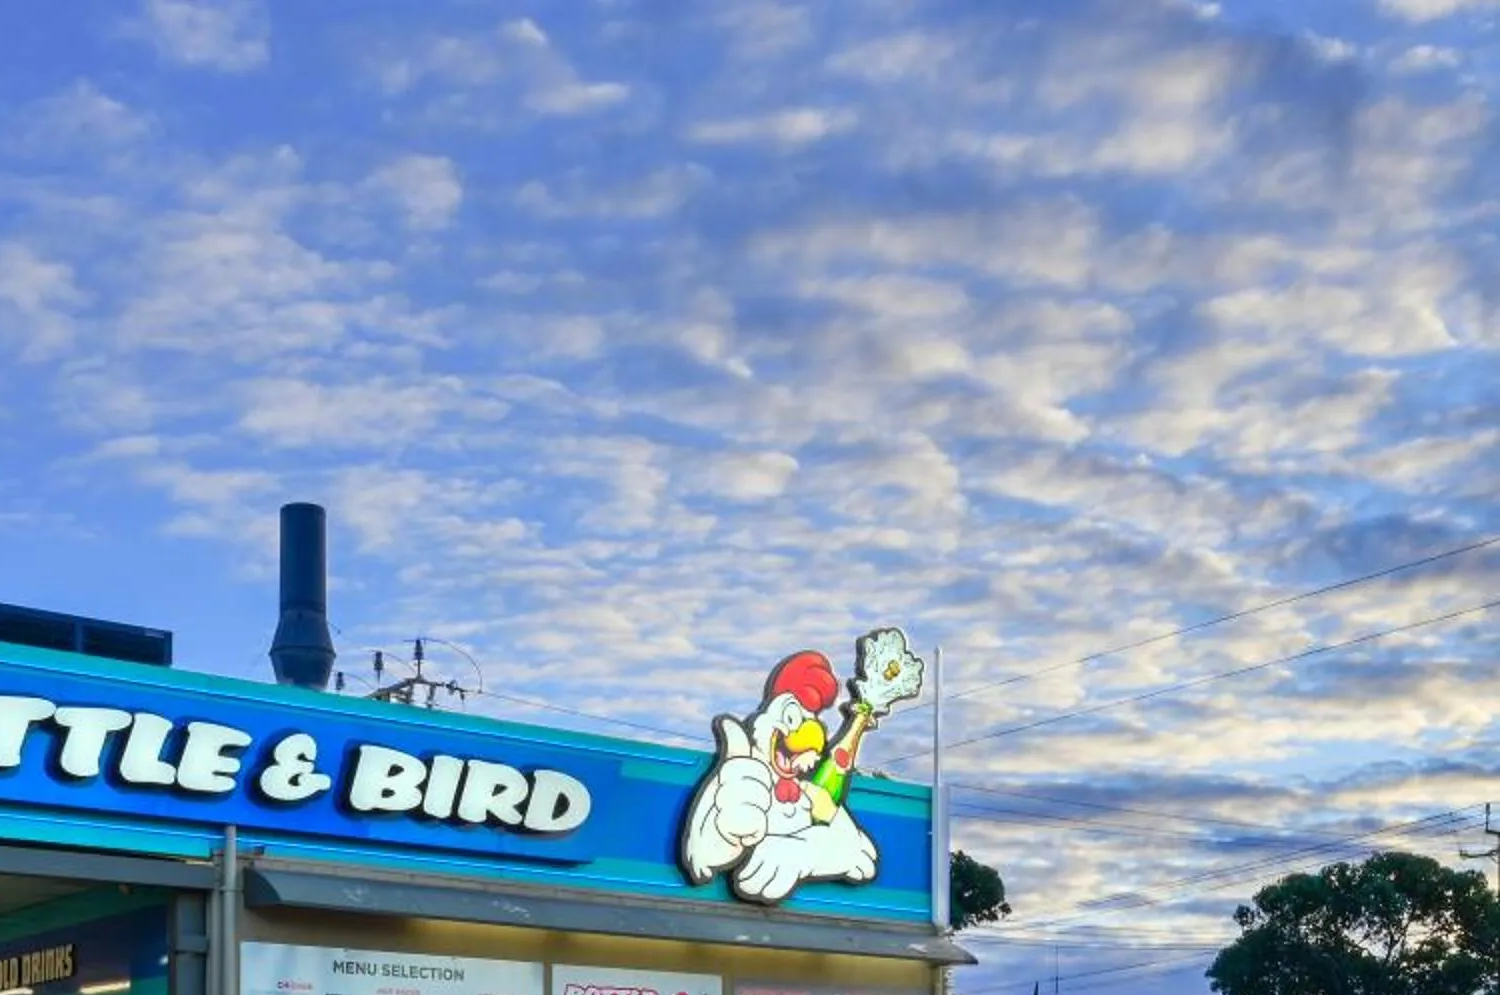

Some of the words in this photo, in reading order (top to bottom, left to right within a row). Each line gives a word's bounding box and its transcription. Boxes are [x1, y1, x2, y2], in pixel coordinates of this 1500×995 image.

[260, 733, 330, 801] &
[350, 744, 592, 833] BIRD
[22, 945, 73, 984] DRINKS
[333, 959, 378, 977] MENU
[381, 963, 465, 982] SELECTION
